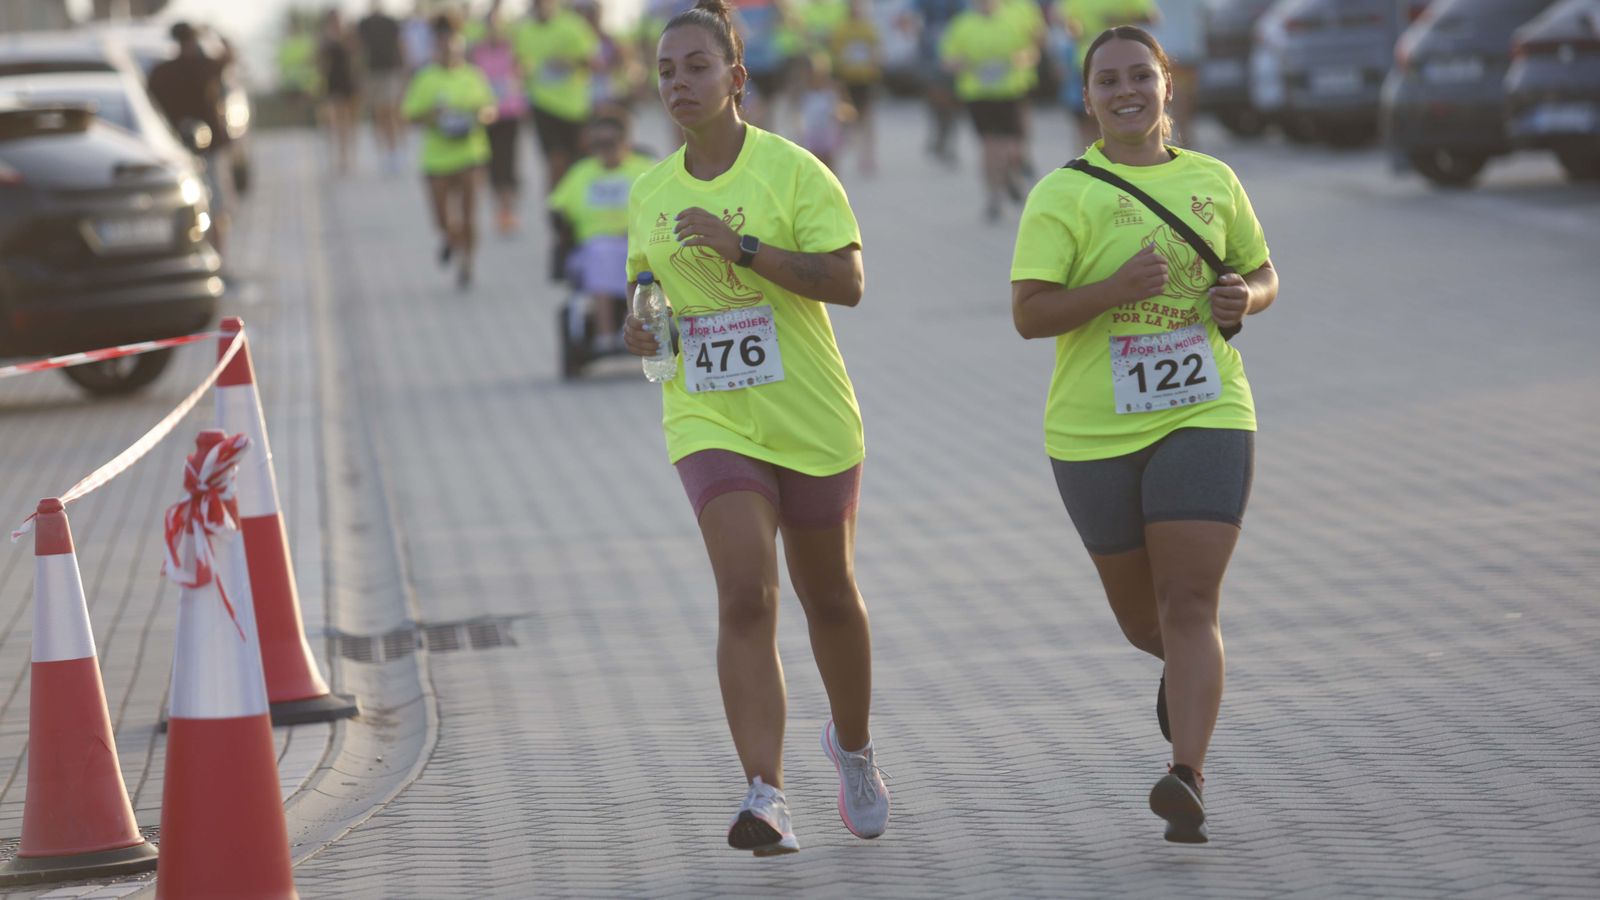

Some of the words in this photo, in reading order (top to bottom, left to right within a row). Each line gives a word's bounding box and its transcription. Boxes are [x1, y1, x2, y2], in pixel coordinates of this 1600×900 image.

[712, 325, 727, 334] LA
[729, 316, 769, 331] MUJER
[1112, 313, 1140, 323] POR
[1145, 314, 1162, 327] LA
[696, 334, 766, 373] 476
[1130, 346, 1154, 355] POR
[1157, 344, 1173, 353] LA
[1175, 335, 1205, 350] MUJER
[1128, 352, 1207, 393] 122
